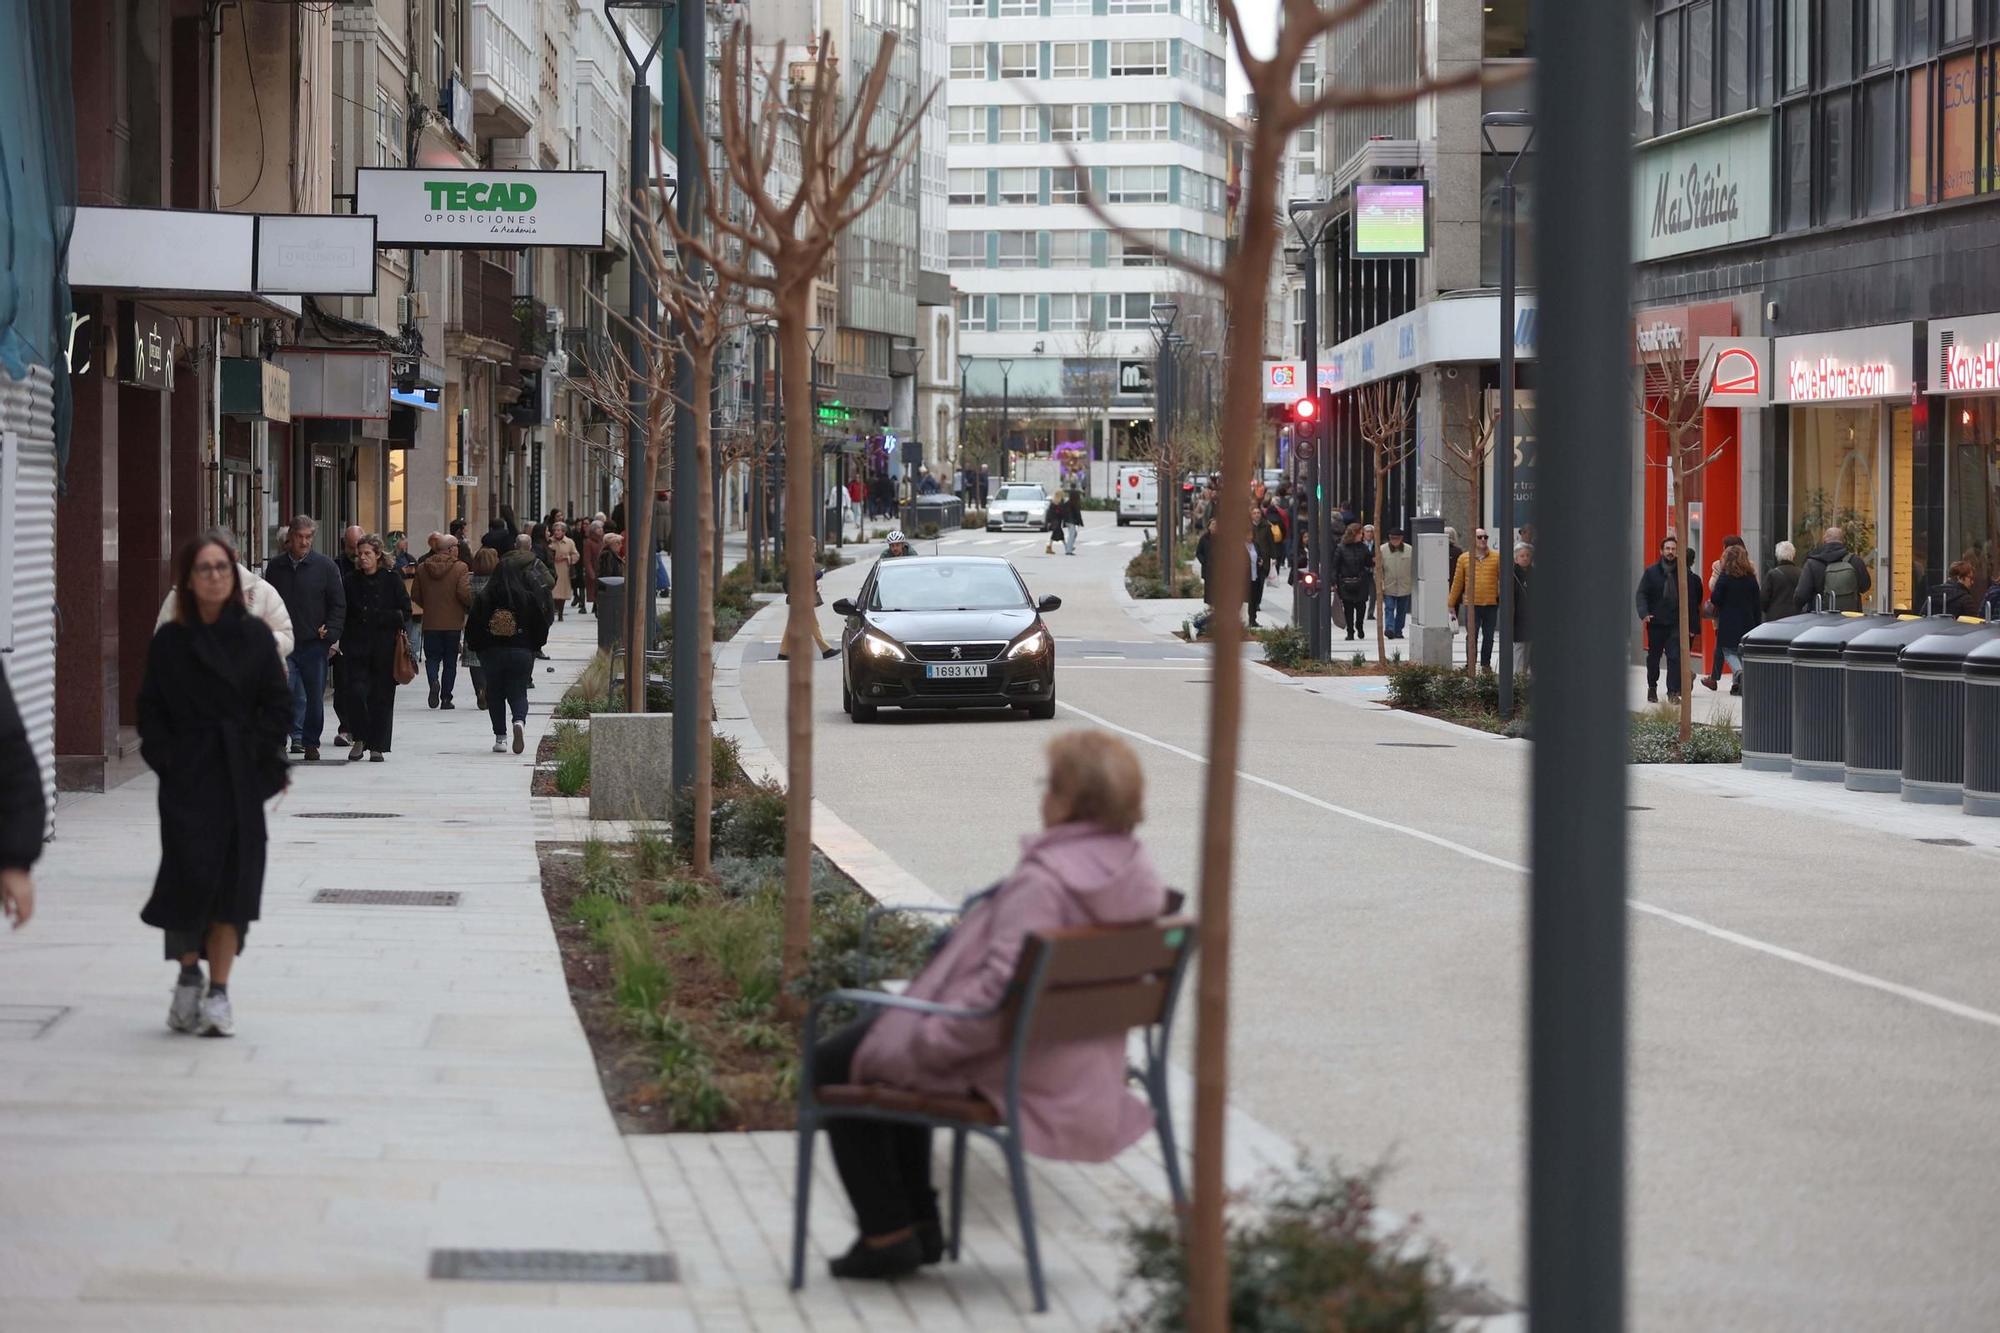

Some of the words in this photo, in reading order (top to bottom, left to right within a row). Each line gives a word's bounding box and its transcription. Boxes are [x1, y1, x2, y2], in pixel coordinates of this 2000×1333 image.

[424, 181, 537, 212] TECAD
[424, 214, 536, 224] OPOSICIONES
[1789, 357, 1885, 400] KaveHome.com
[935, 666, 961, 676] 1693
[965, 666, 985, 676] KYV
